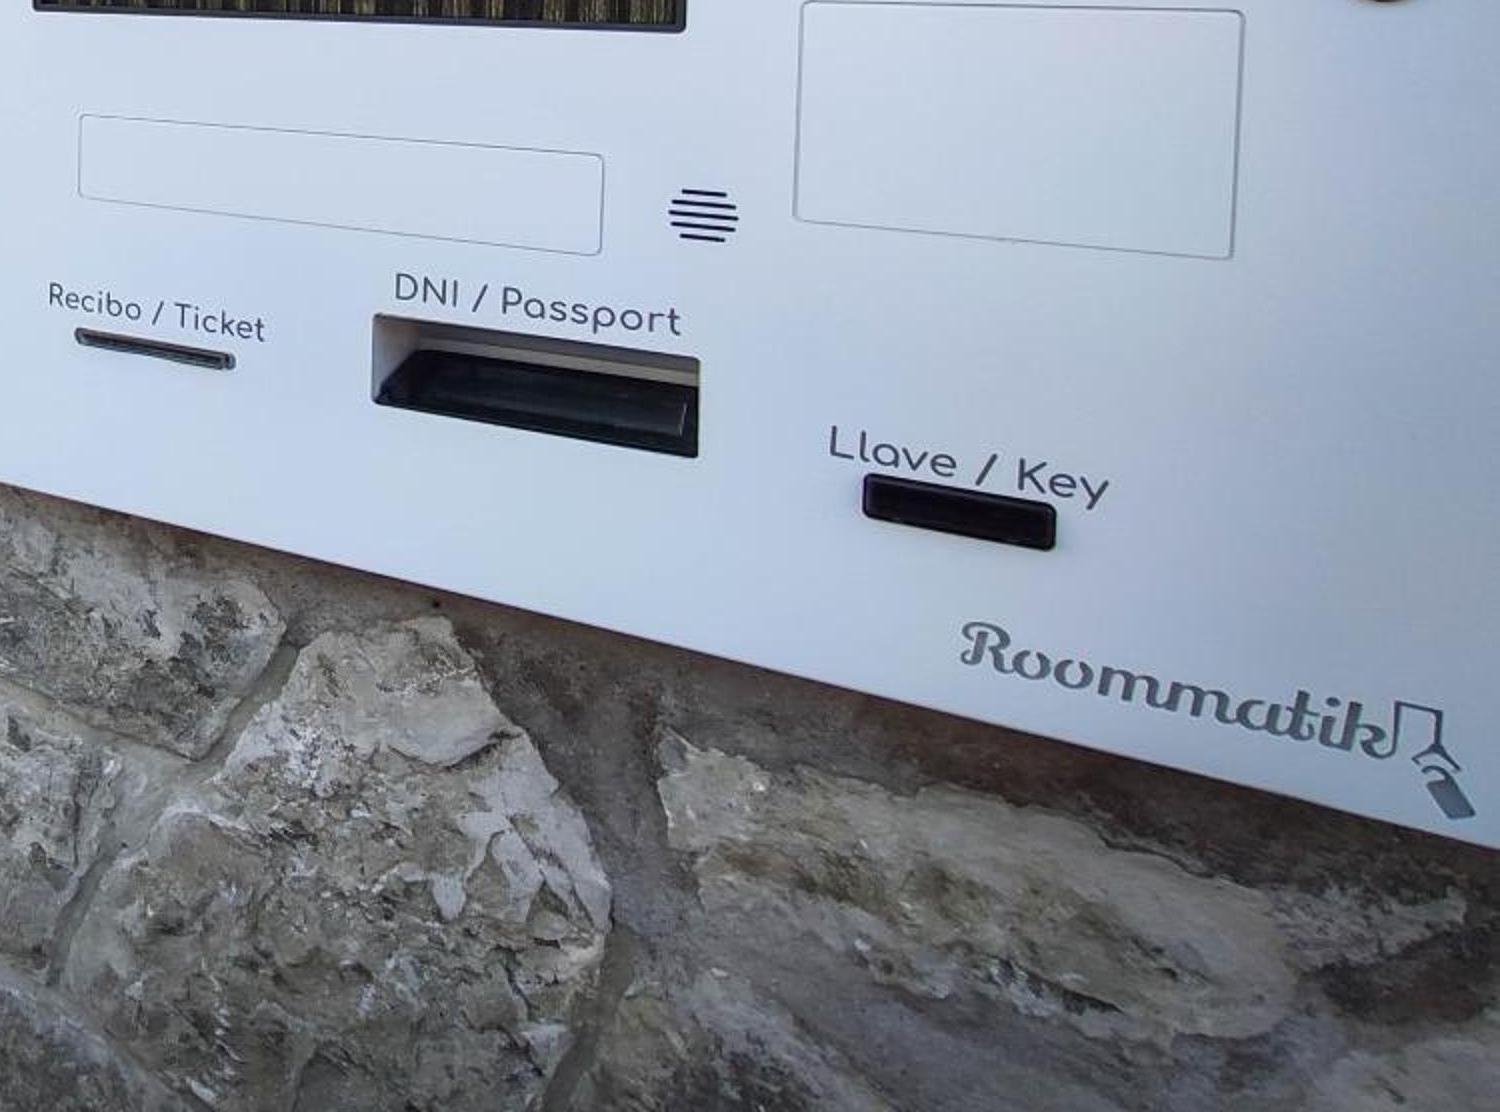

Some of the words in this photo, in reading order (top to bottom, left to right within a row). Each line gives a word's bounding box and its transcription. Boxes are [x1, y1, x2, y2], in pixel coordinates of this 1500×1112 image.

[49, 282, 141, 321] Recibo
[152, 301, 165, 326] /
[174, 302, 265, 342] Ticket
[395, 272, 459, 307] DNI
[472, 284, 488, 312] /
[502, 287, 681, 335] Passport
[829, 425, 957, 477] Llave
[975, 453, 998, 486] /
[1017, 458, 1109, 510] Key
[960, 621, 1398, 759] Roommatik
